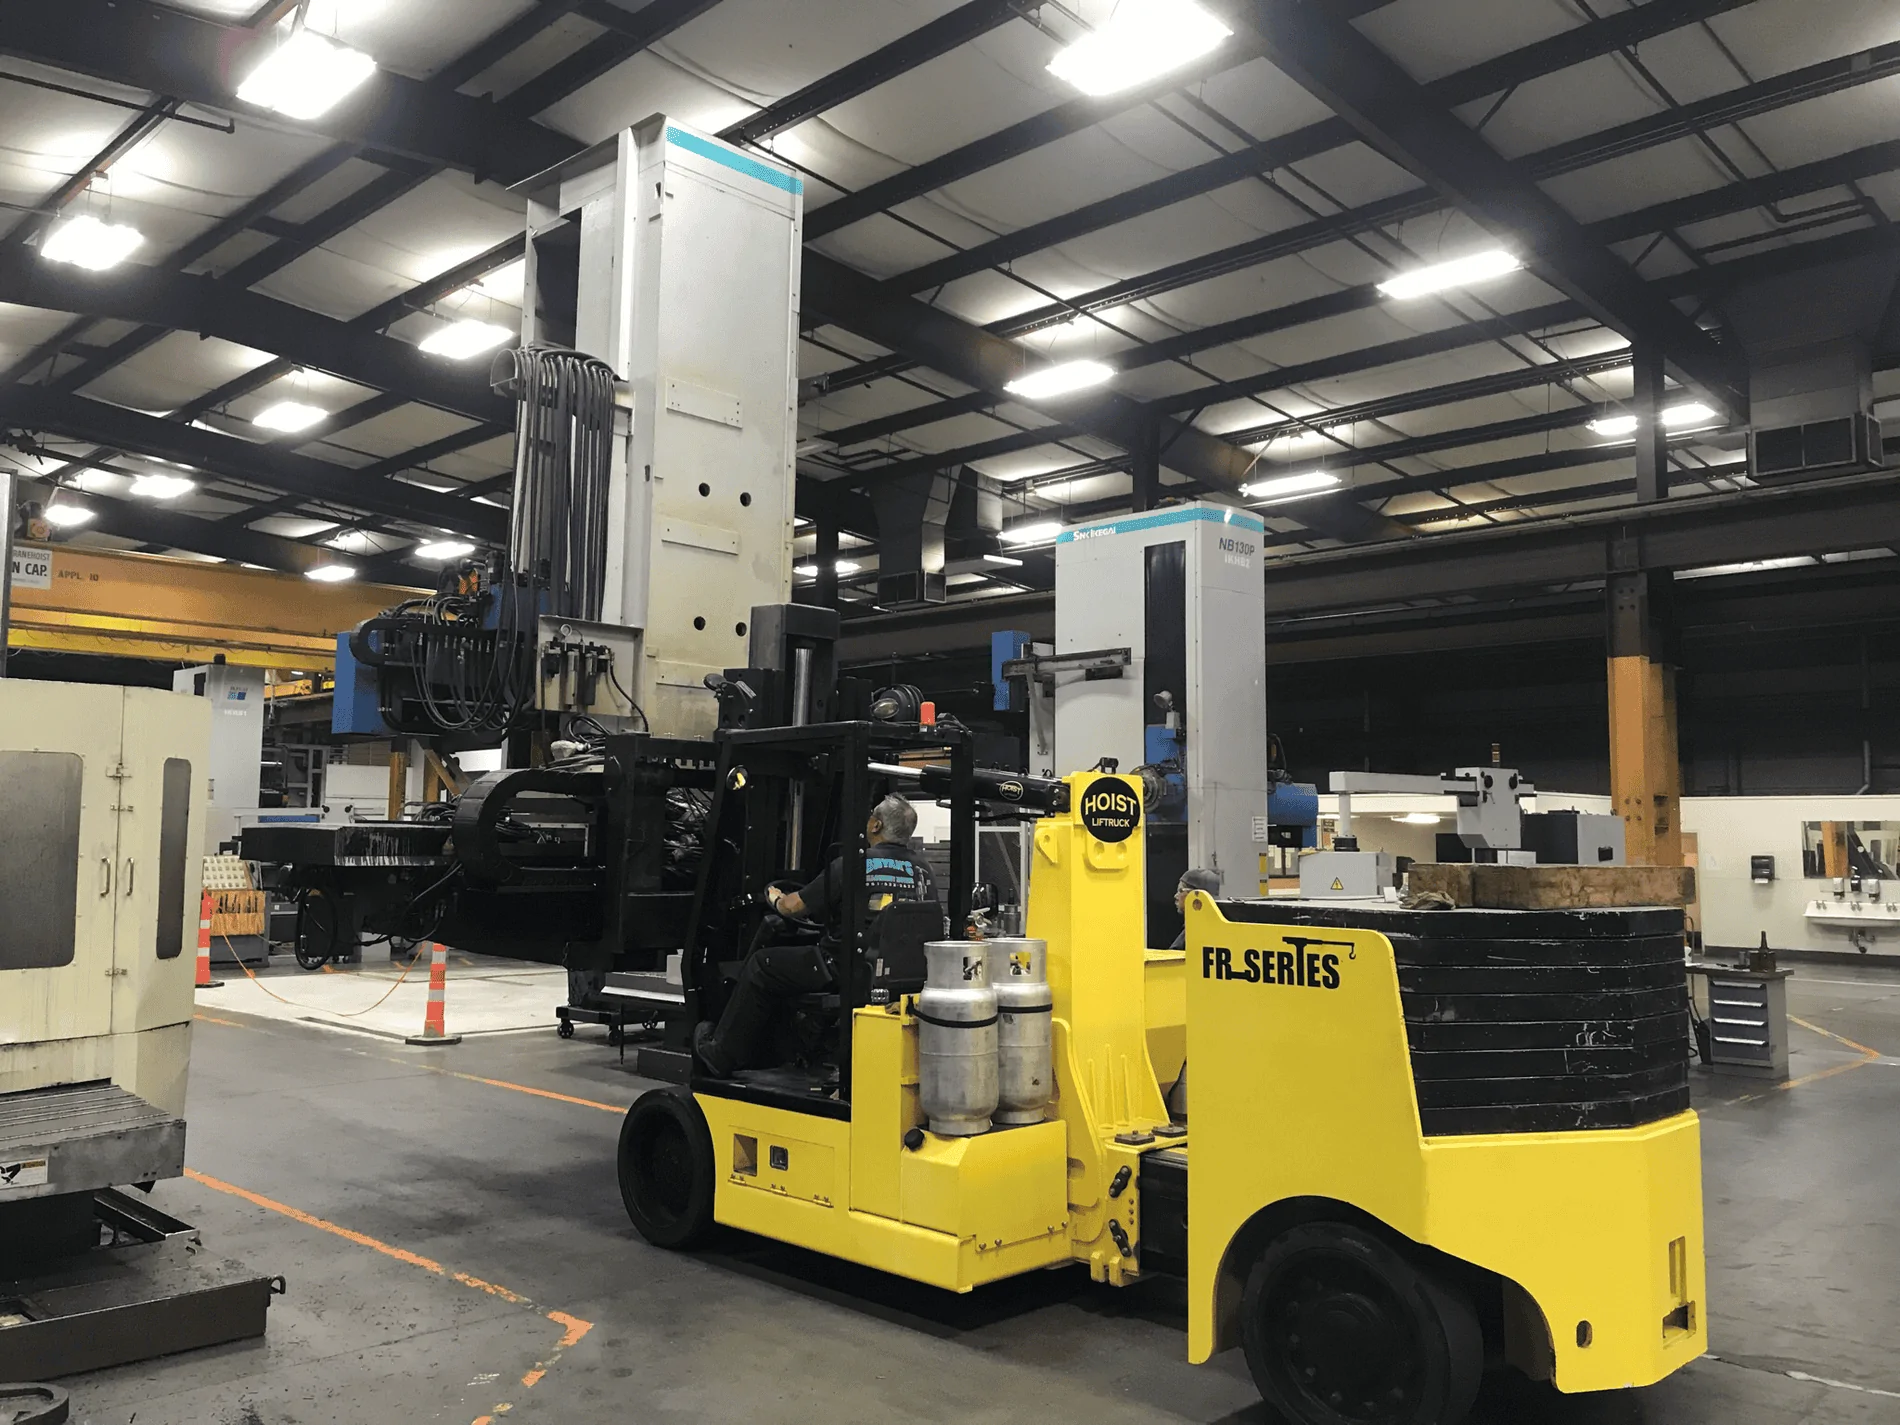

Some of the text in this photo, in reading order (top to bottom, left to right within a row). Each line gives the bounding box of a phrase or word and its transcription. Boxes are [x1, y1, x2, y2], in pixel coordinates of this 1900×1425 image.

[1219, 537, 1255, 556] NB130P
[1085, 793, 1136, 815] HOIST
[1092, 818, 1129, 827] LIFTRUCK
